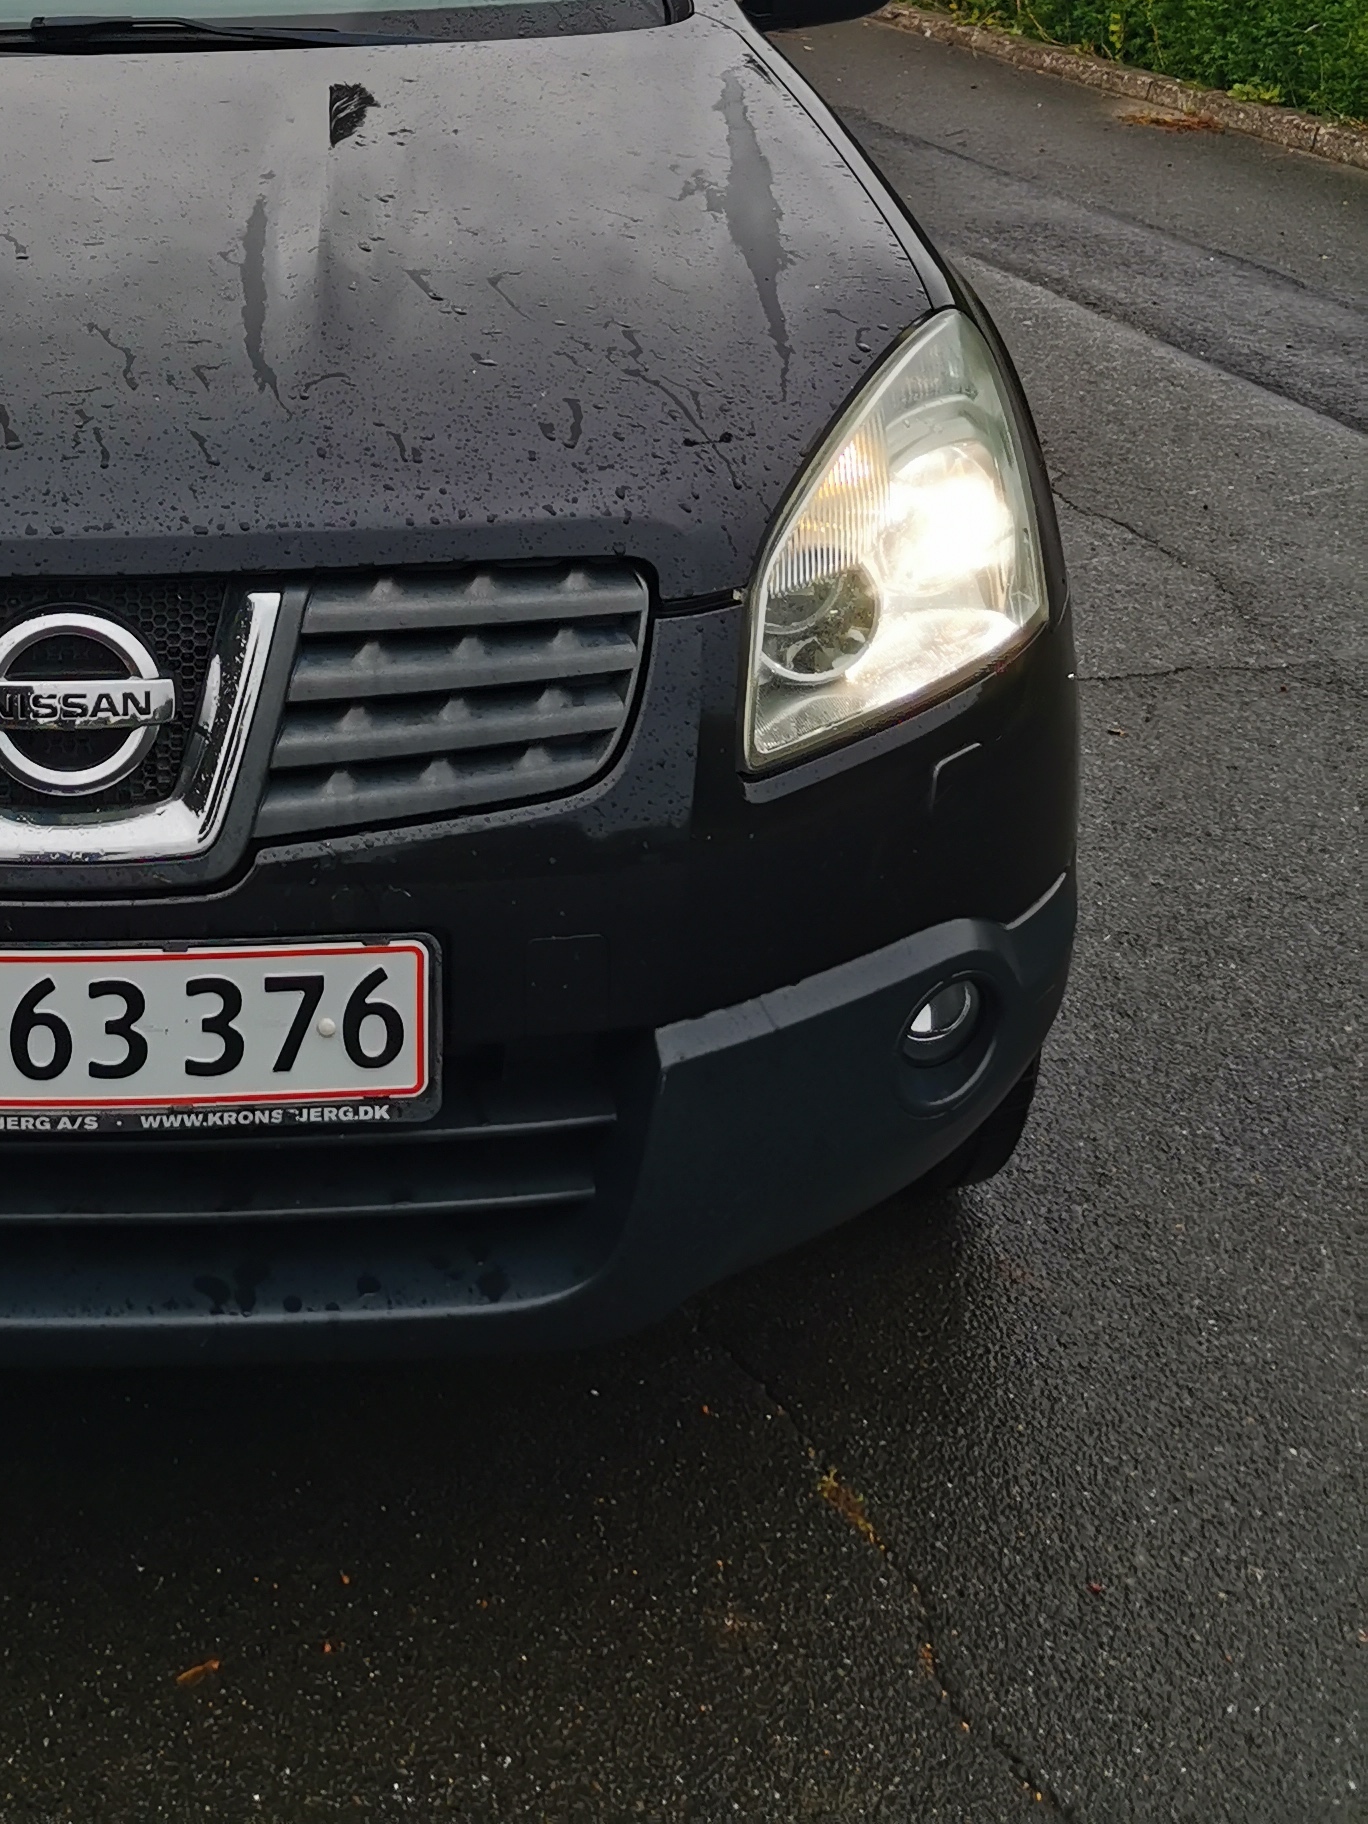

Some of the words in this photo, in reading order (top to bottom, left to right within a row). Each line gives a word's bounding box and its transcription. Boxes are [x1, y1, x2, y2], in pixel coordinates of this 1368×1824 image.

[8, 976, 150, 1082] 63
[183, 966, 406, 1079] 376
[56, 1115, 100, 1131] A/S
[139, 1104, 392, 1129] WWW.KRONSJERG.DK
